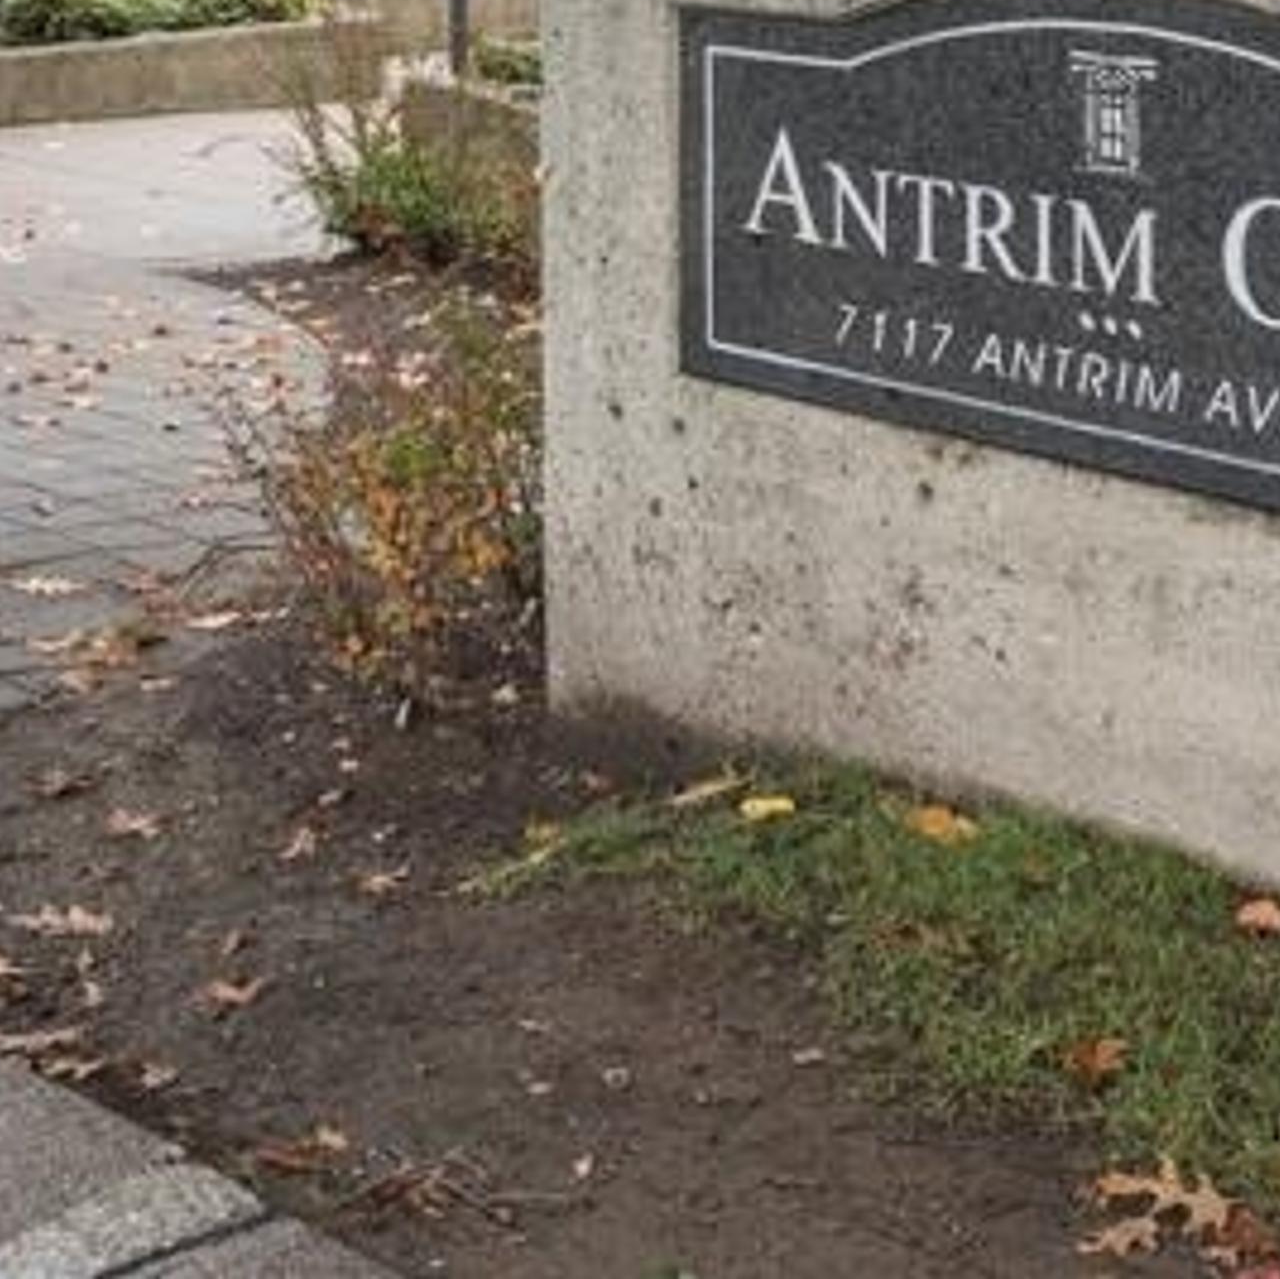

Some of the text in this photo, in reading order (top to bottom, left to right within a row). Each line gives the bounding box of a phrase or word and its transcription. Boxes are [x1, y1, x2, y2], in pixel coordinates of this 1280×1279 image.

[743, 127, 1161, 307] ANTRIM
[835, 302, 955, 364] 7117
[971, 332, 1183, 414] ANTRIM
